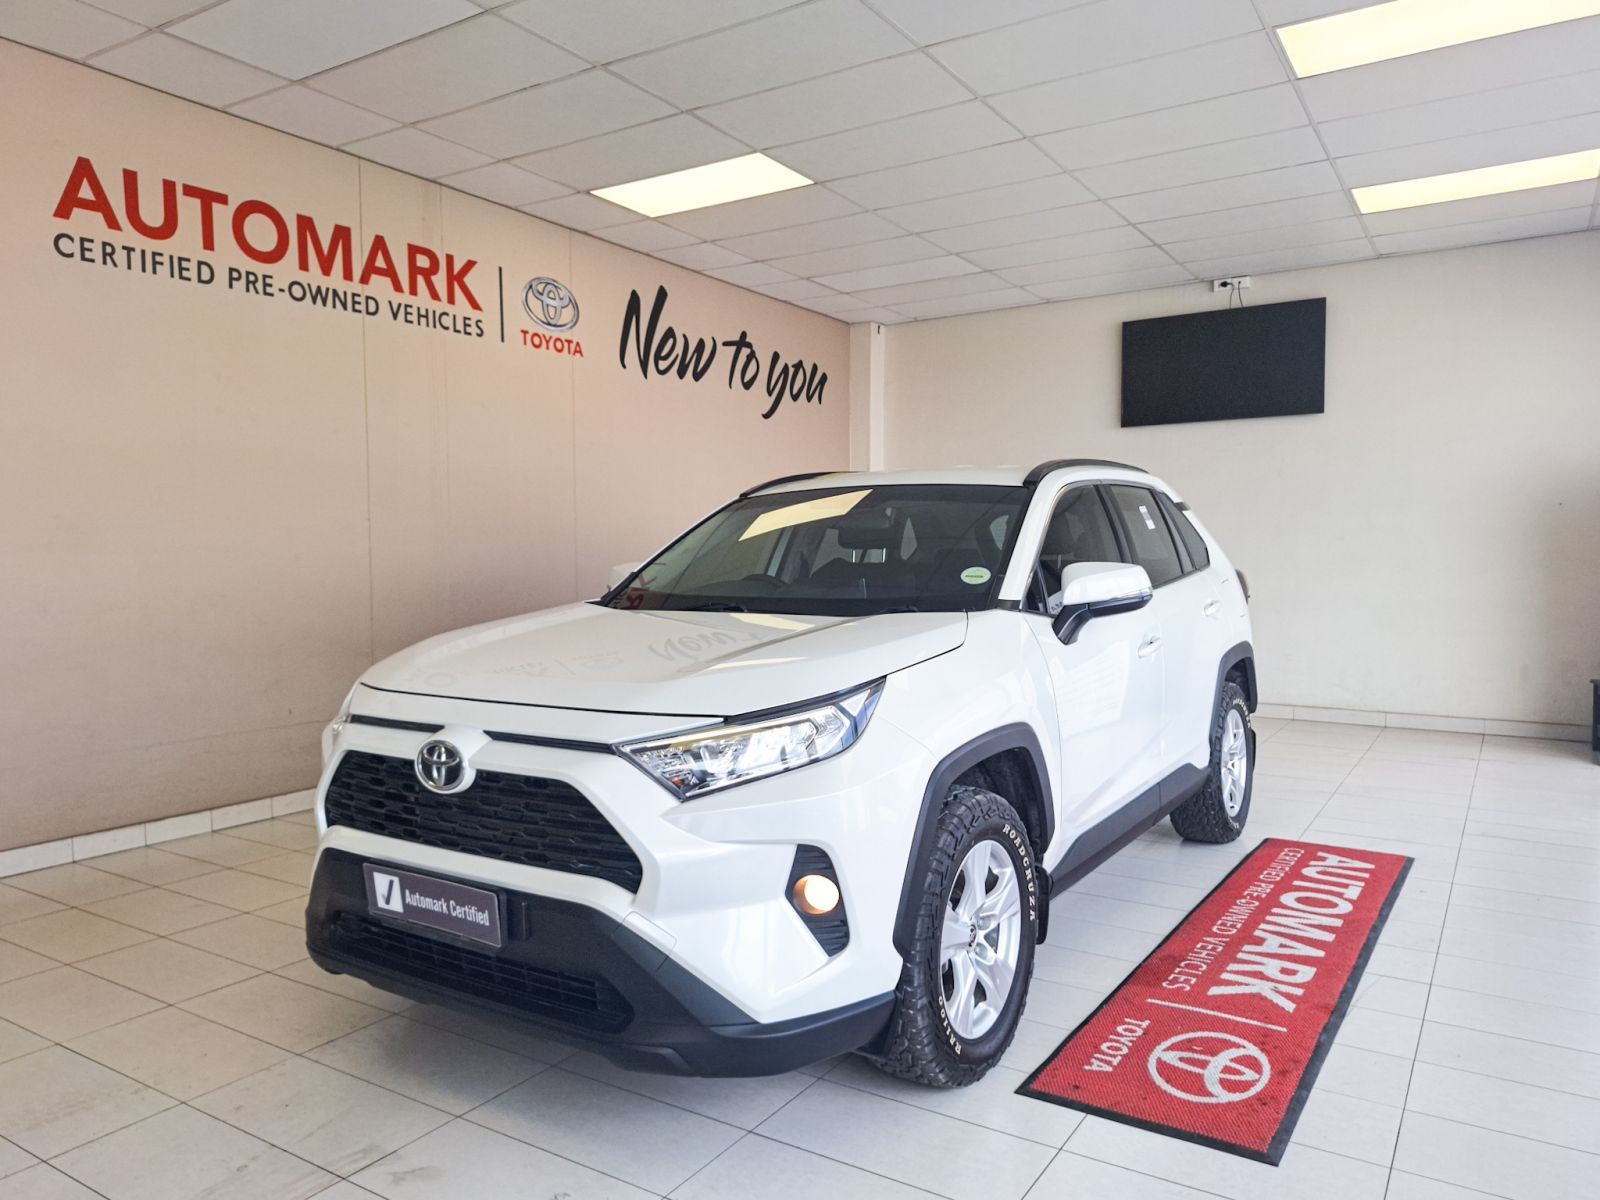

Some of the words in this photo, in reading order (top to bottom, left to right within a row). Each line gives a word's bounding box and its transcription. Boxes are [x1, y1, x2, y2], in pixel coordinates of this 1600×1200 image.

[53, 156, 483, 312] AUTOMARK
[53, 232, 215, 285] CERTIFIED
[228, 266, 379, 317] PRE-OWNED
[388, 300, 484, 338] VEHICLES
[520, 329, 584, 358] TOYOTA
[619, 285, 717, 382] New
[722, 330, 760, 390] to
[761, 351, 828, 420] you
[1002, 822, 1036, 922] ROADCRUZA
[1259, 848, 1305, 883] CERTIFIED
[405, 888, 449, 915] Automark
[450, 900, 490, 927] Certified
[1207, 851, 1375, 1013] AUTOMARK
[1211, 881, 1275, 936] PRE-OWNED
[1162, 936, 1231, 992] VEHICLES
[1084, 1017, 1151, 1073] TOYOTA
